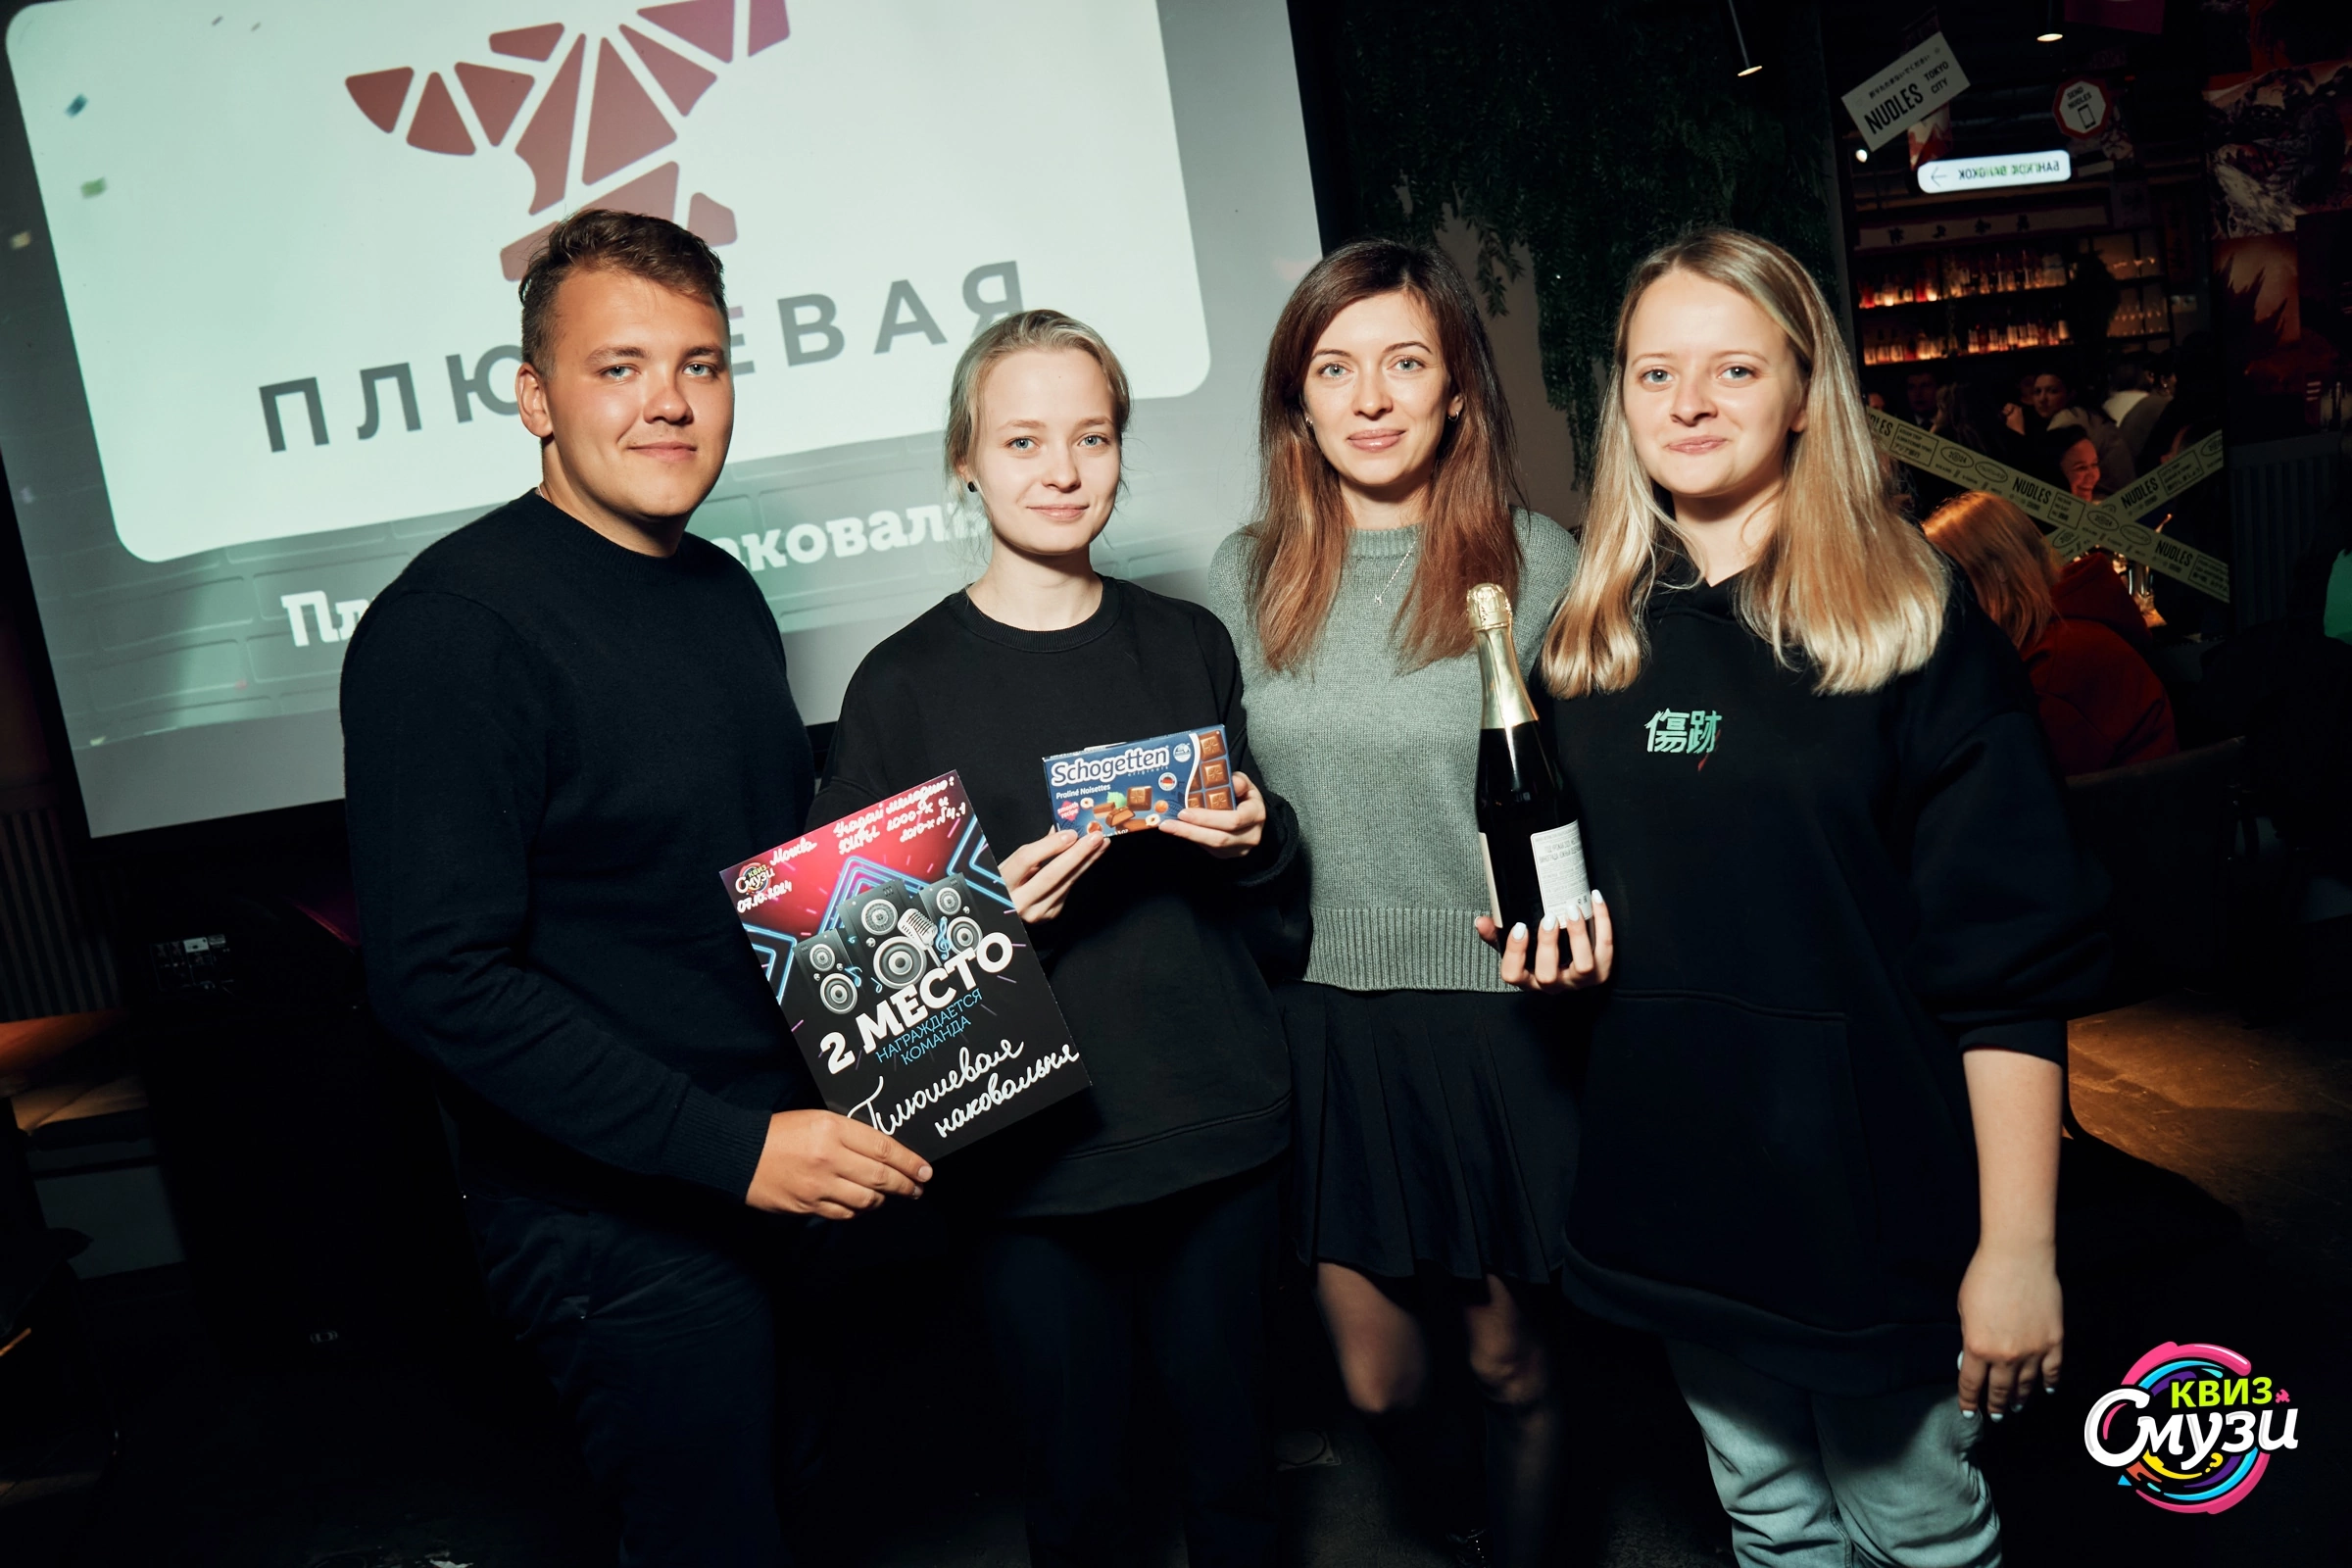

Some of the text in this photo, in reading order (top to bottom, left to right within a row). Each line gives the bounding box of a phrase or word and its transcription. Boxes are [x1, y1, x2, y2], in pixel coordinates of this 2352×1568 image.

[1924, 61, 1949, 81] TOKYO
[1931, 77, 1948, 95] CITY
[1863, 82, 1924, 135] NUDLES
[1868, 413, 1893, 437] DLES
[2012, 476, 2052, 505] NUDLES
[2121, 476, 2159, 510] NUDLES
[2155, 539, 2193, 567] NUDLES
[1643, 708, 1722, 754] 傷跡
[1052, 748, 1169, 786] Schogetten
[1055, 784, 1111, 800] Praliné Noisettes
[1057, 802, 1079, 814] smooth
[1061, 808, 1079, 819] recipe
[769, 837, 818, 866] Москва
[735, 867, 775, 894] Смузи
[748, 864, 767, 878] КВИЗ
[737, 879, 792, 913] 07.10.2024
[819, 932, 1013, 1075] 2 МЕСТО
[875, 988, 983, 1063] НАГРАЖДАЕТСЯ
[901, 1015, 971, 1065] КОМАНДА
[847, 1039, 1024, 1136] Плюшевая
[934, 1044, 1080, 1139] наковальня
